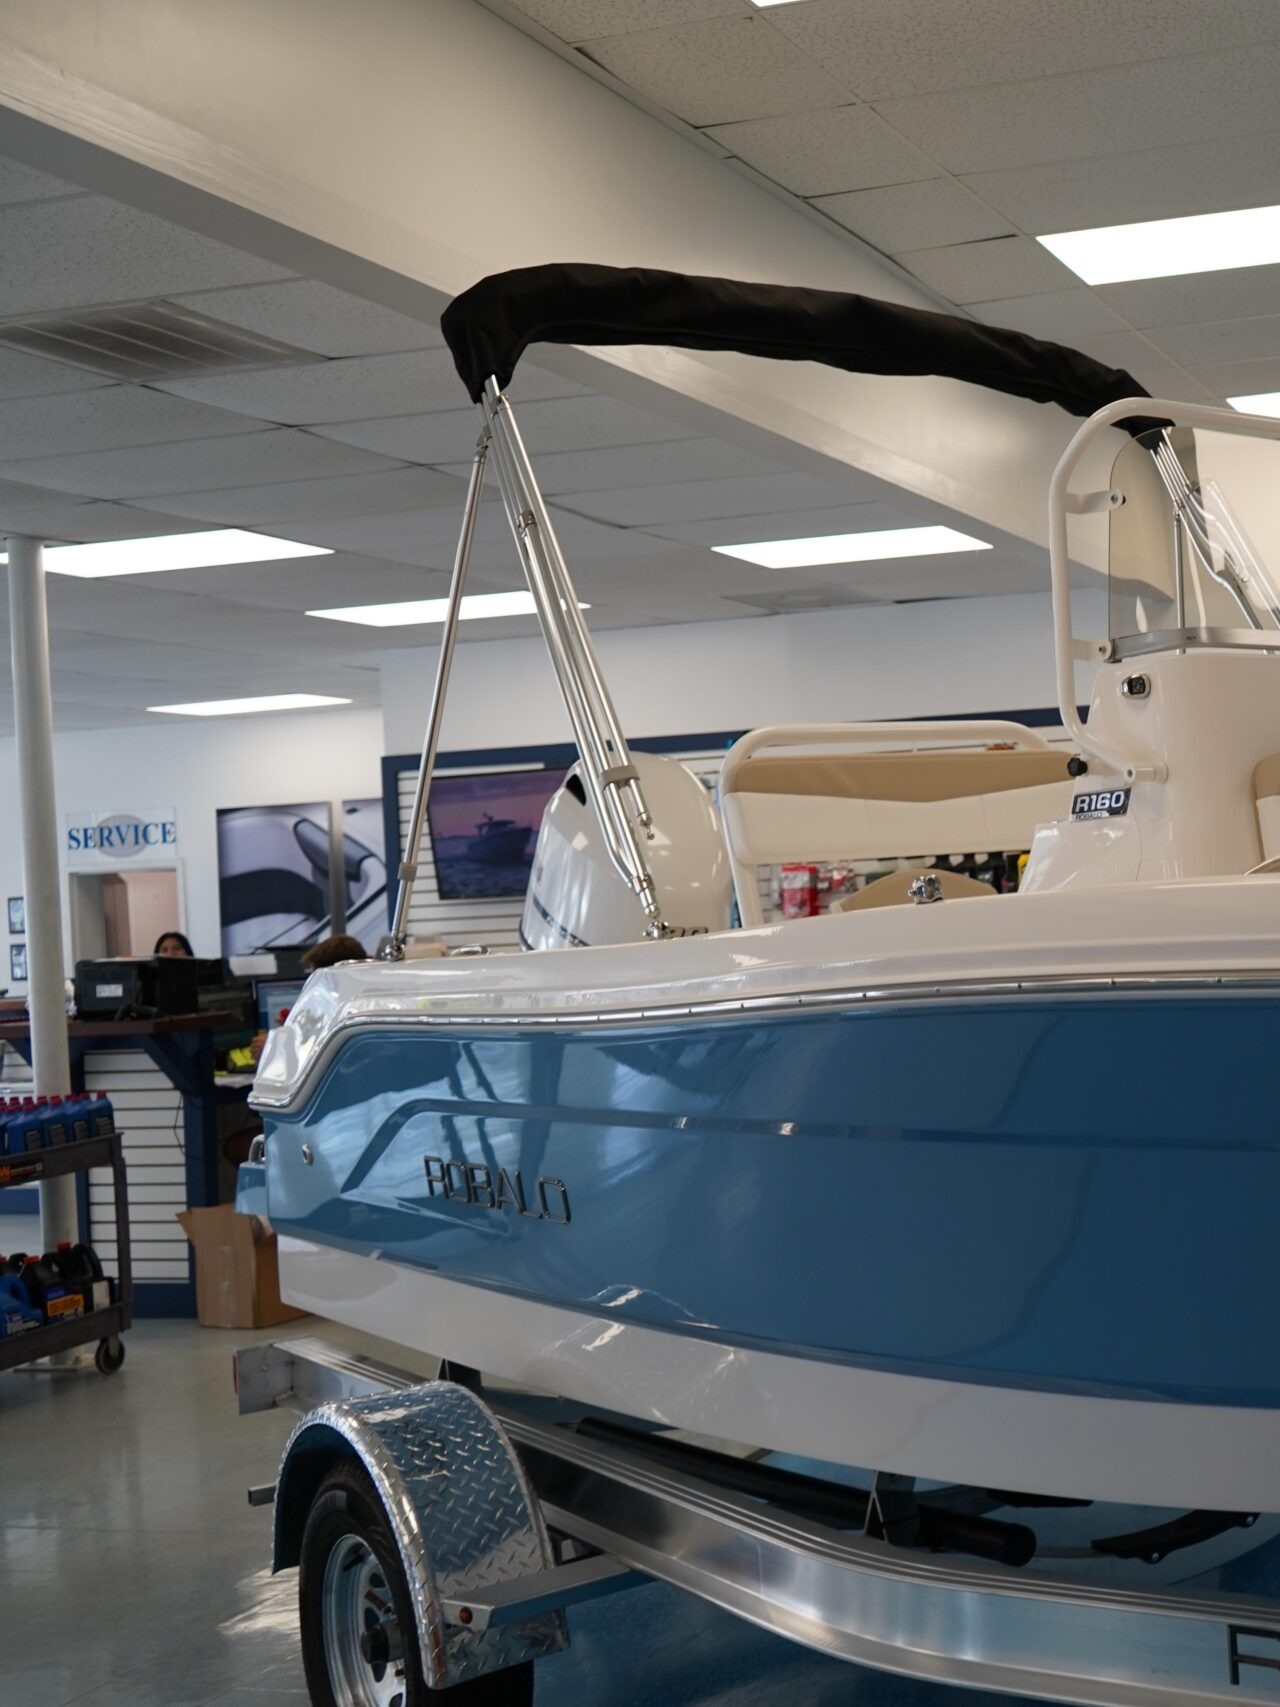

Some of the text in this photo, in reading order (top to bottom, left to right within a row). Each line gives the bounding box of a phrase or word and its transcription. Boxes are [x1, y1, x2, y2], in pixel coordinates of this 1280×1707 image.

[1075, 790, 1125, 813] R160
[67, 820, 176, 851] SERVICE
[423, 1154, 572, 1226] ROBALO
